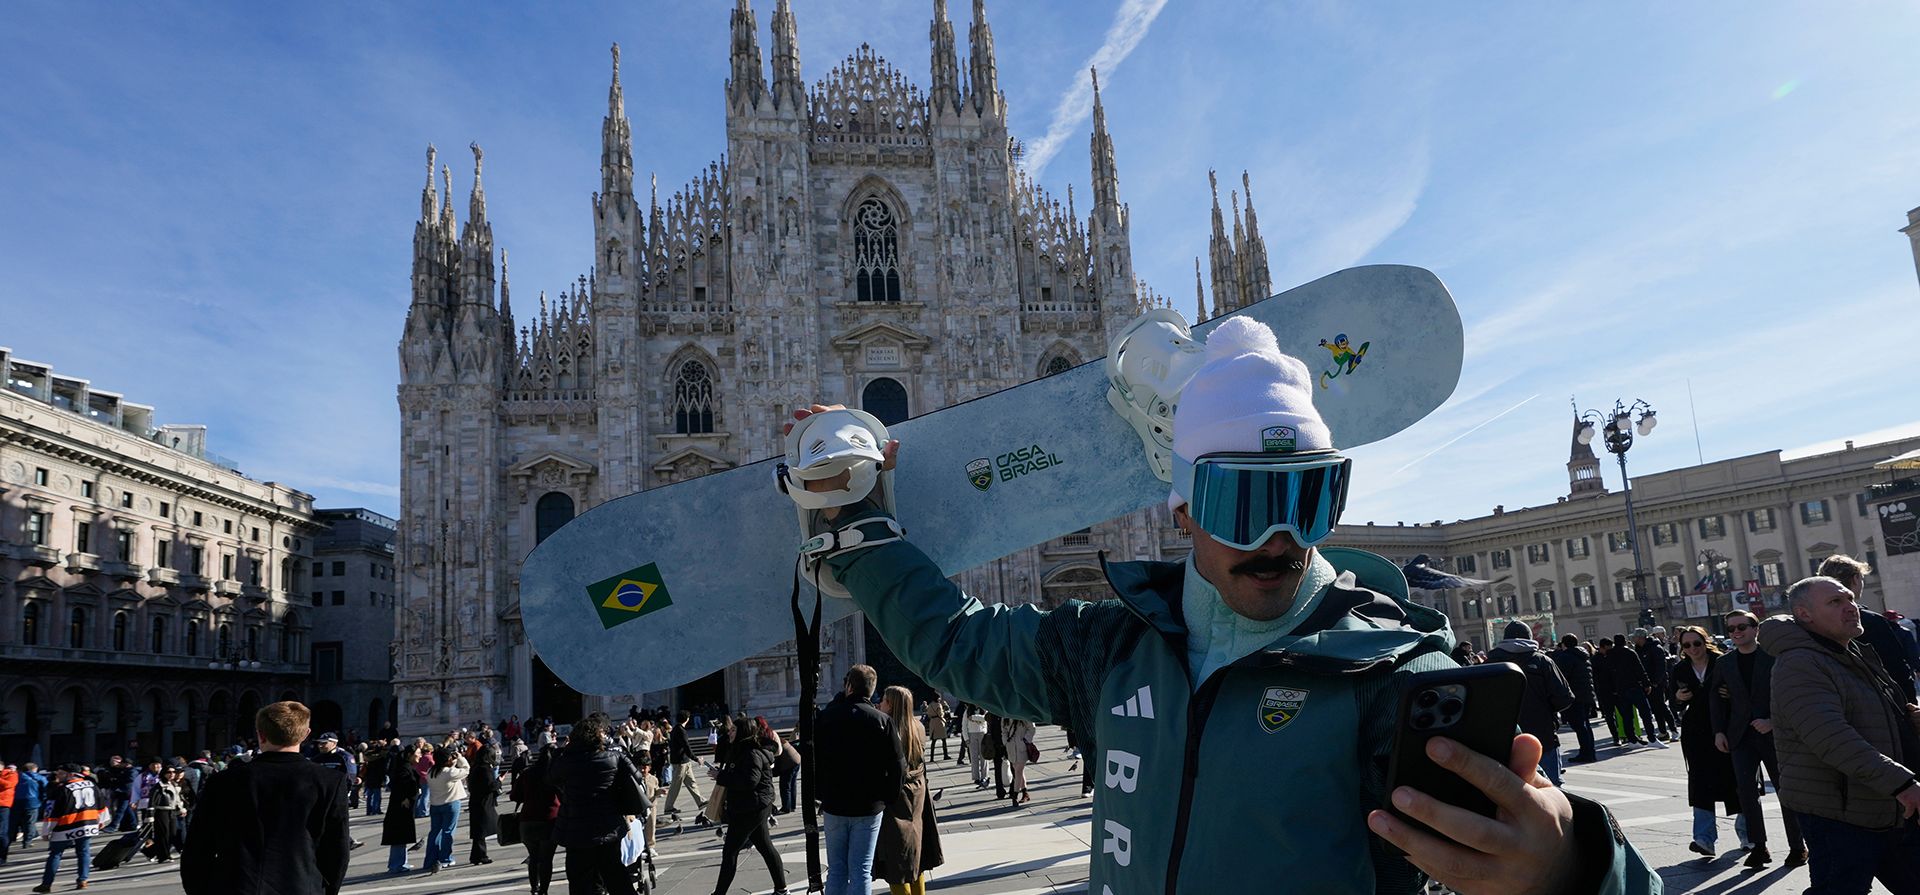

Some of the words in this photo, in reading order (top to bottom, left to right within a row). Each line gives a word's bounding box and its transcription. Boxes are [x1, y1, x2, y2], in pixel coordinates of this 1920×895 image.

[996, 444, 1045, 468] CASA
[999, 453, 1063, 482] BRASIL
[1747, 582, 1760, 594] M
[1265, 699, 1299, 708] BRASIL
[72, 787, 96, 809] 10
[1102, 749, 1141, 895] BR
